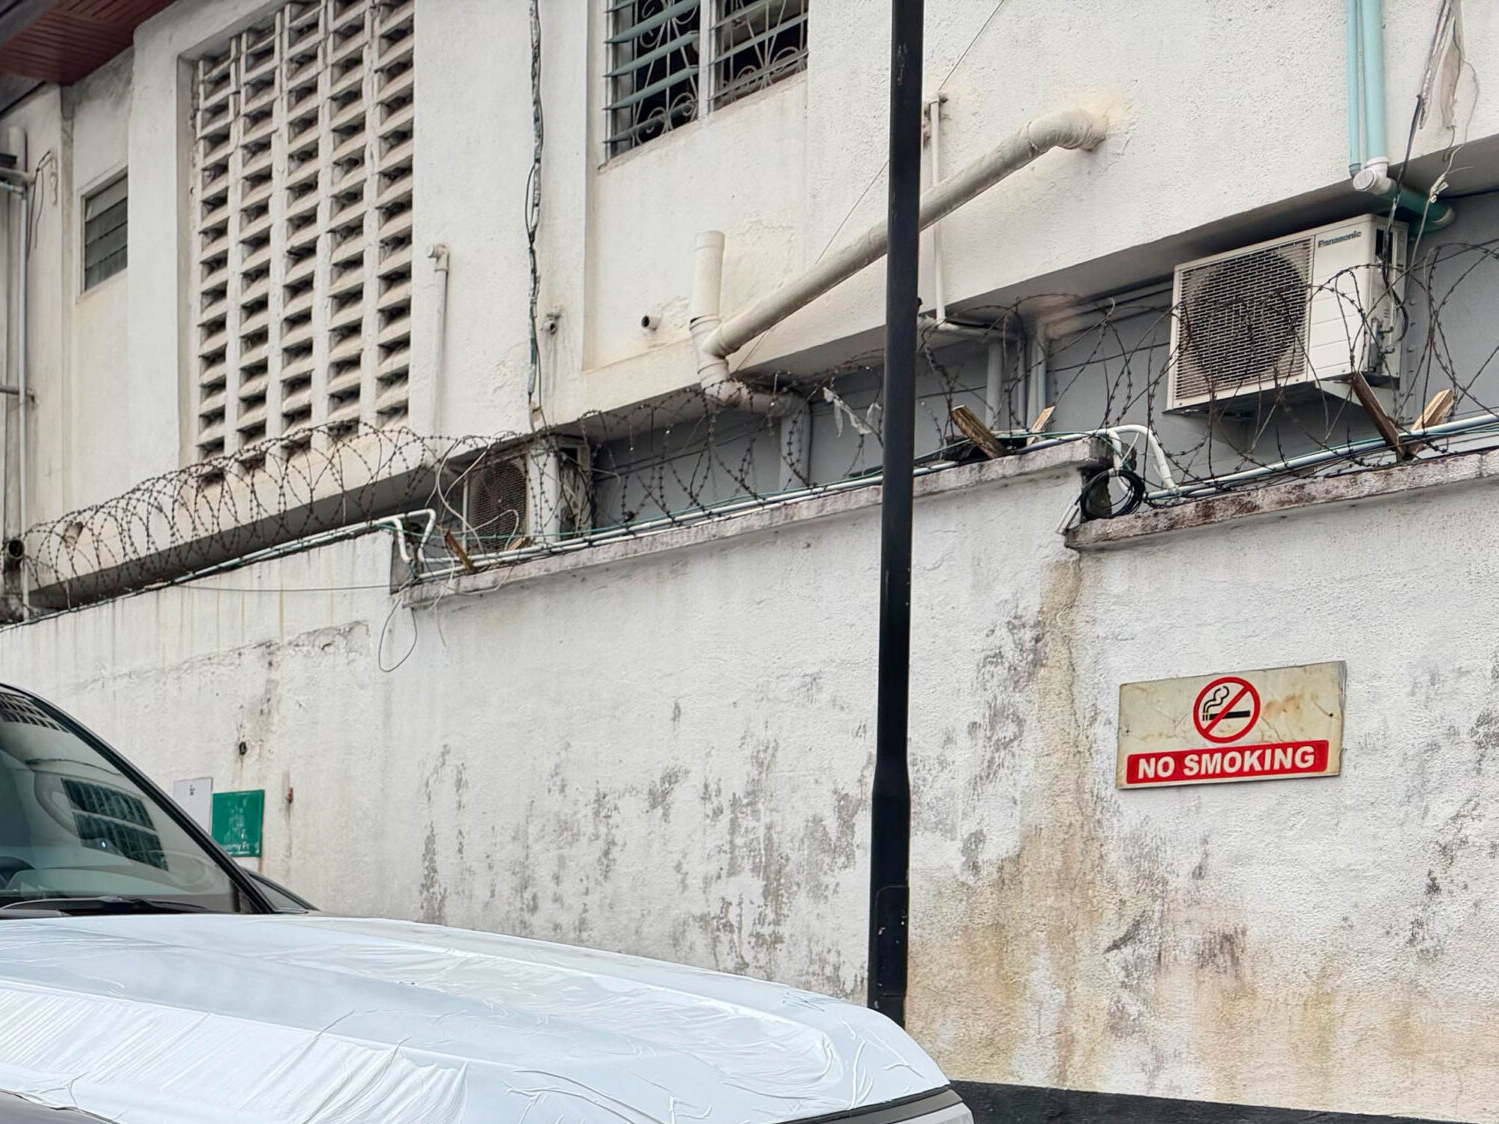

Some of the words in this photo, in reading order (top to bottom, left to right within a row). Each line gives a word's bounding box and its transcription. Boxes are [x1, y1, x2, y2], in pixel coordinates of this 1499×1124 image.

[1317, 230, 1361, 248] Panasonic
[1137, 756, 1175, 780] NO
[1183, 745, 1315, 775] SMOKING
